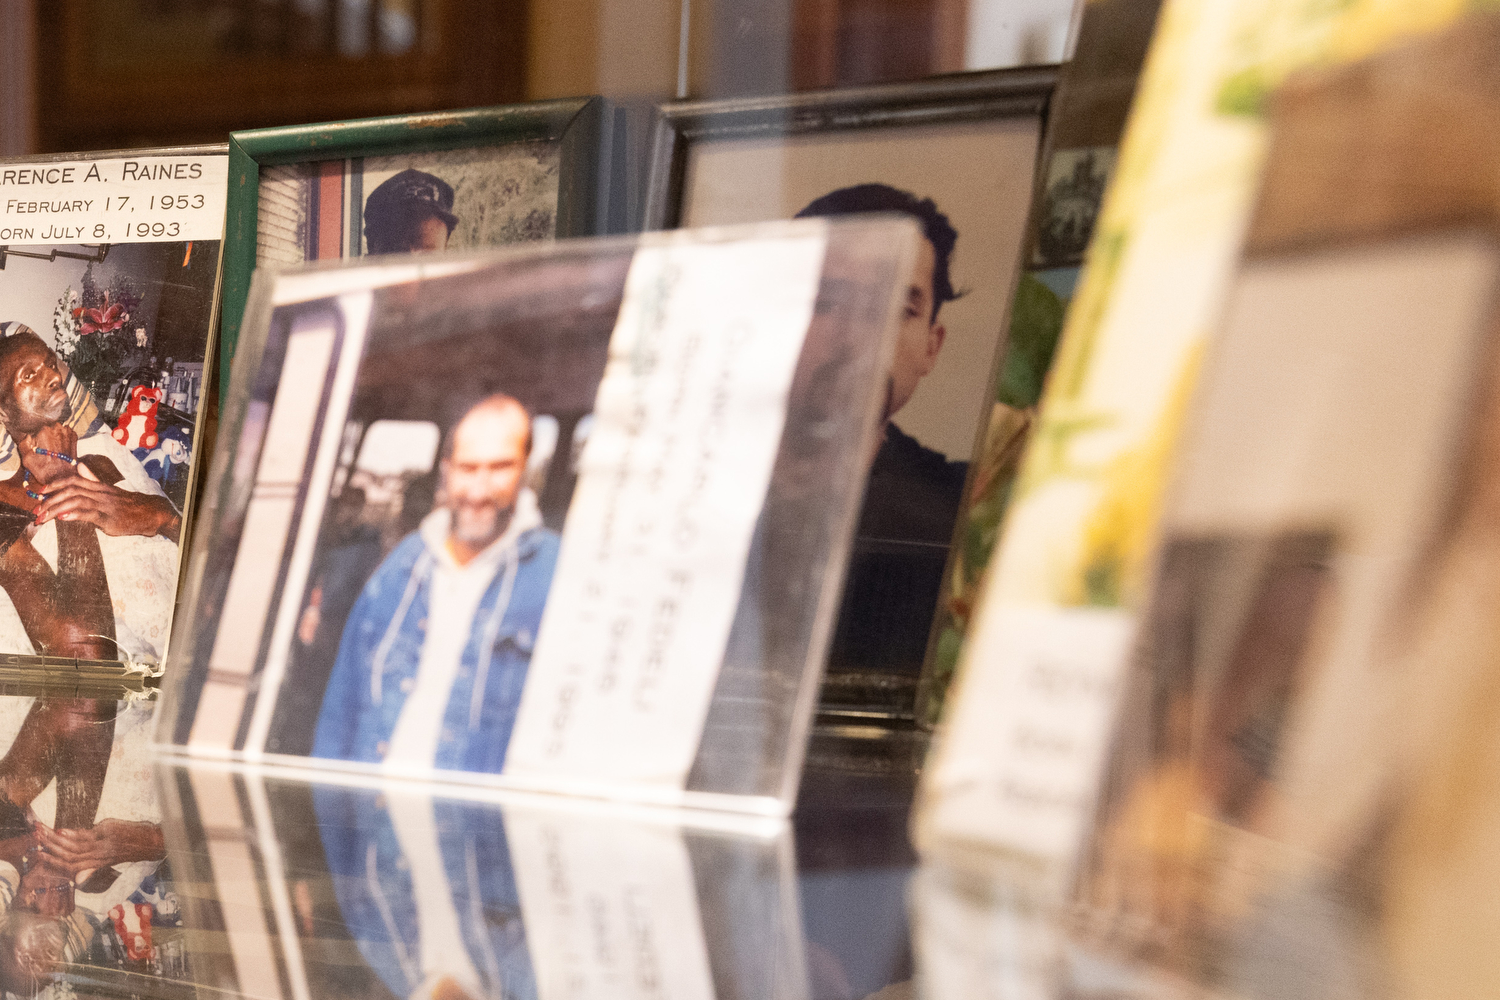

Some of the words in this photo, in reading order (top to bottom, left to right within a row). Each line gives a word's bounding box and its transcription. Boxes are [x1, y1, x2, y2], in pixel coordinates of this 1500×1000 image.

[83, 162, 108, 183] A.
[121, 160, 203, 181] RAINES
[6, 198, 94, 214] FEBRUARY
[105, 195, 135, 212] 17,
[149, 193, 205, 211] 1953
[40, 224, 85, 240] JULY
[92, 222, 111, 239] 8,
[125, 221, 181, 238] 1993
